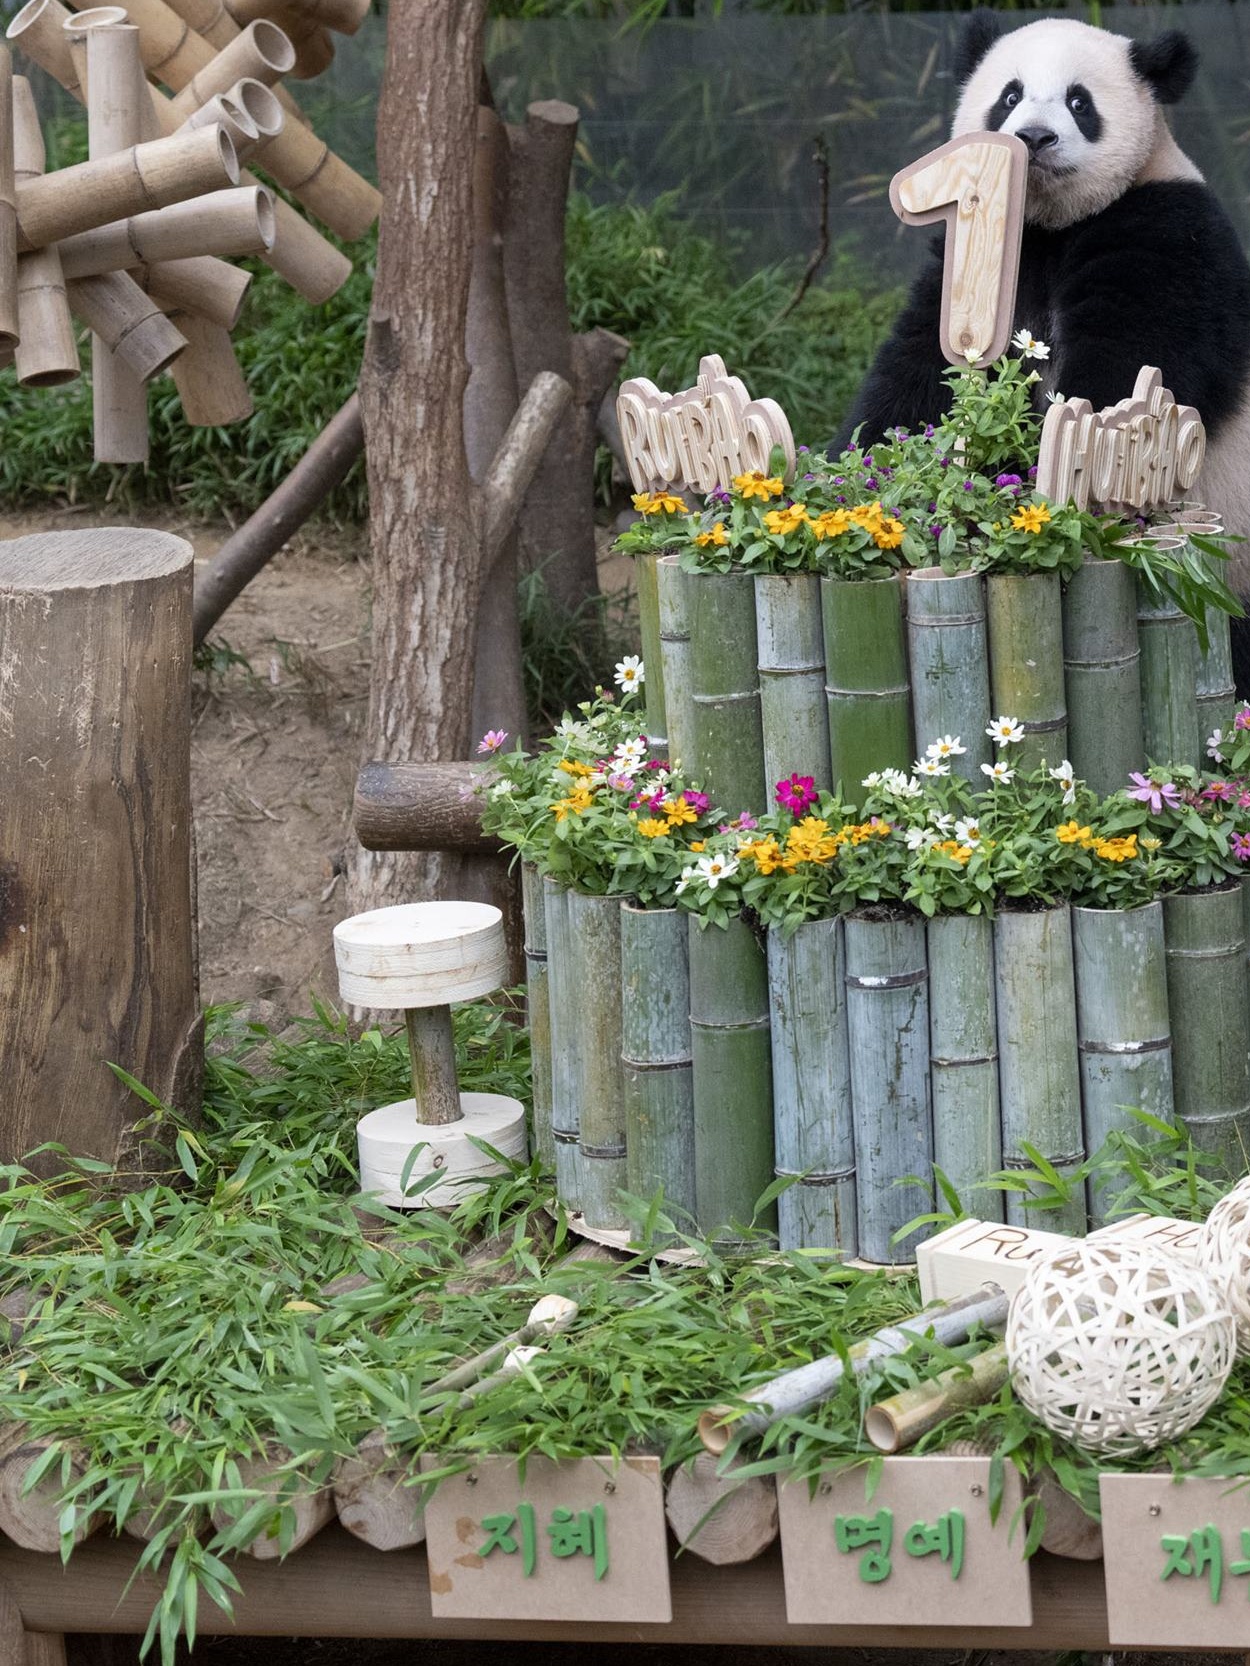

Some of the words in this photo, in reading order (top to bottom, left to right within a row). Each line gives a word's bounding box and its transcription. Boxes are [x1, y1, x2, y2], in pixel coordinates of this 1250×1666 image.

[897, 140, 1013, 358] 1
[478, 1501, 609, 1582] 지혜
[834, 1507, 966, 1583] 명예
